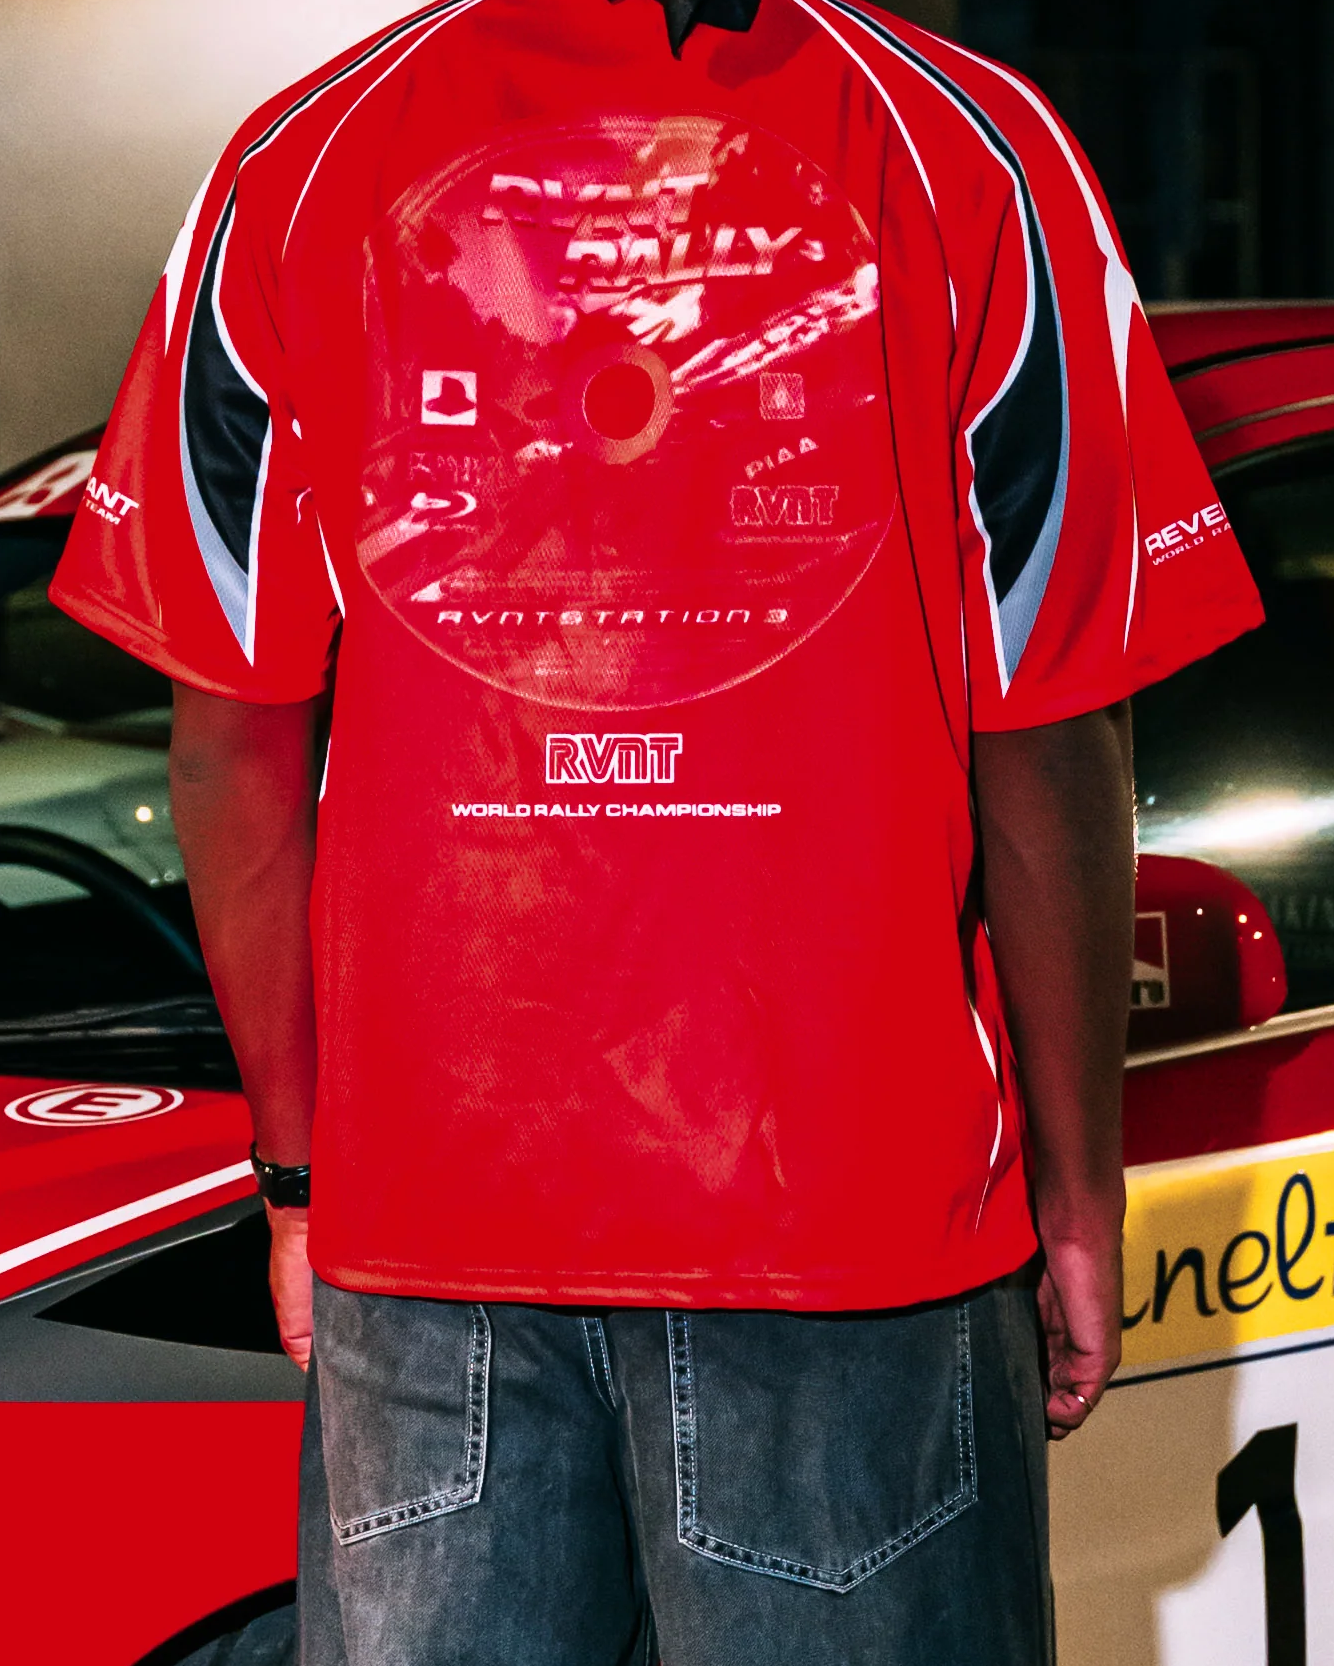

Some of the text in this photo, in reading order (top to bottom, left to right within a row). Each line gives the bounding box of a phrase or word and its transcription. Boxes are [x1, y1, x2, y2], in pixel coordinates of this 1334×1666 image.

[744, 436, 819, 480] PIAA
[85, 498, 122, 525] TEAM
[1144, 501, 1227, 557] REVE
[1152, 535, 1205, 566] WORLD
[452, 803, 782, 819] WORLD RALLY CHAMPIONSHIP
